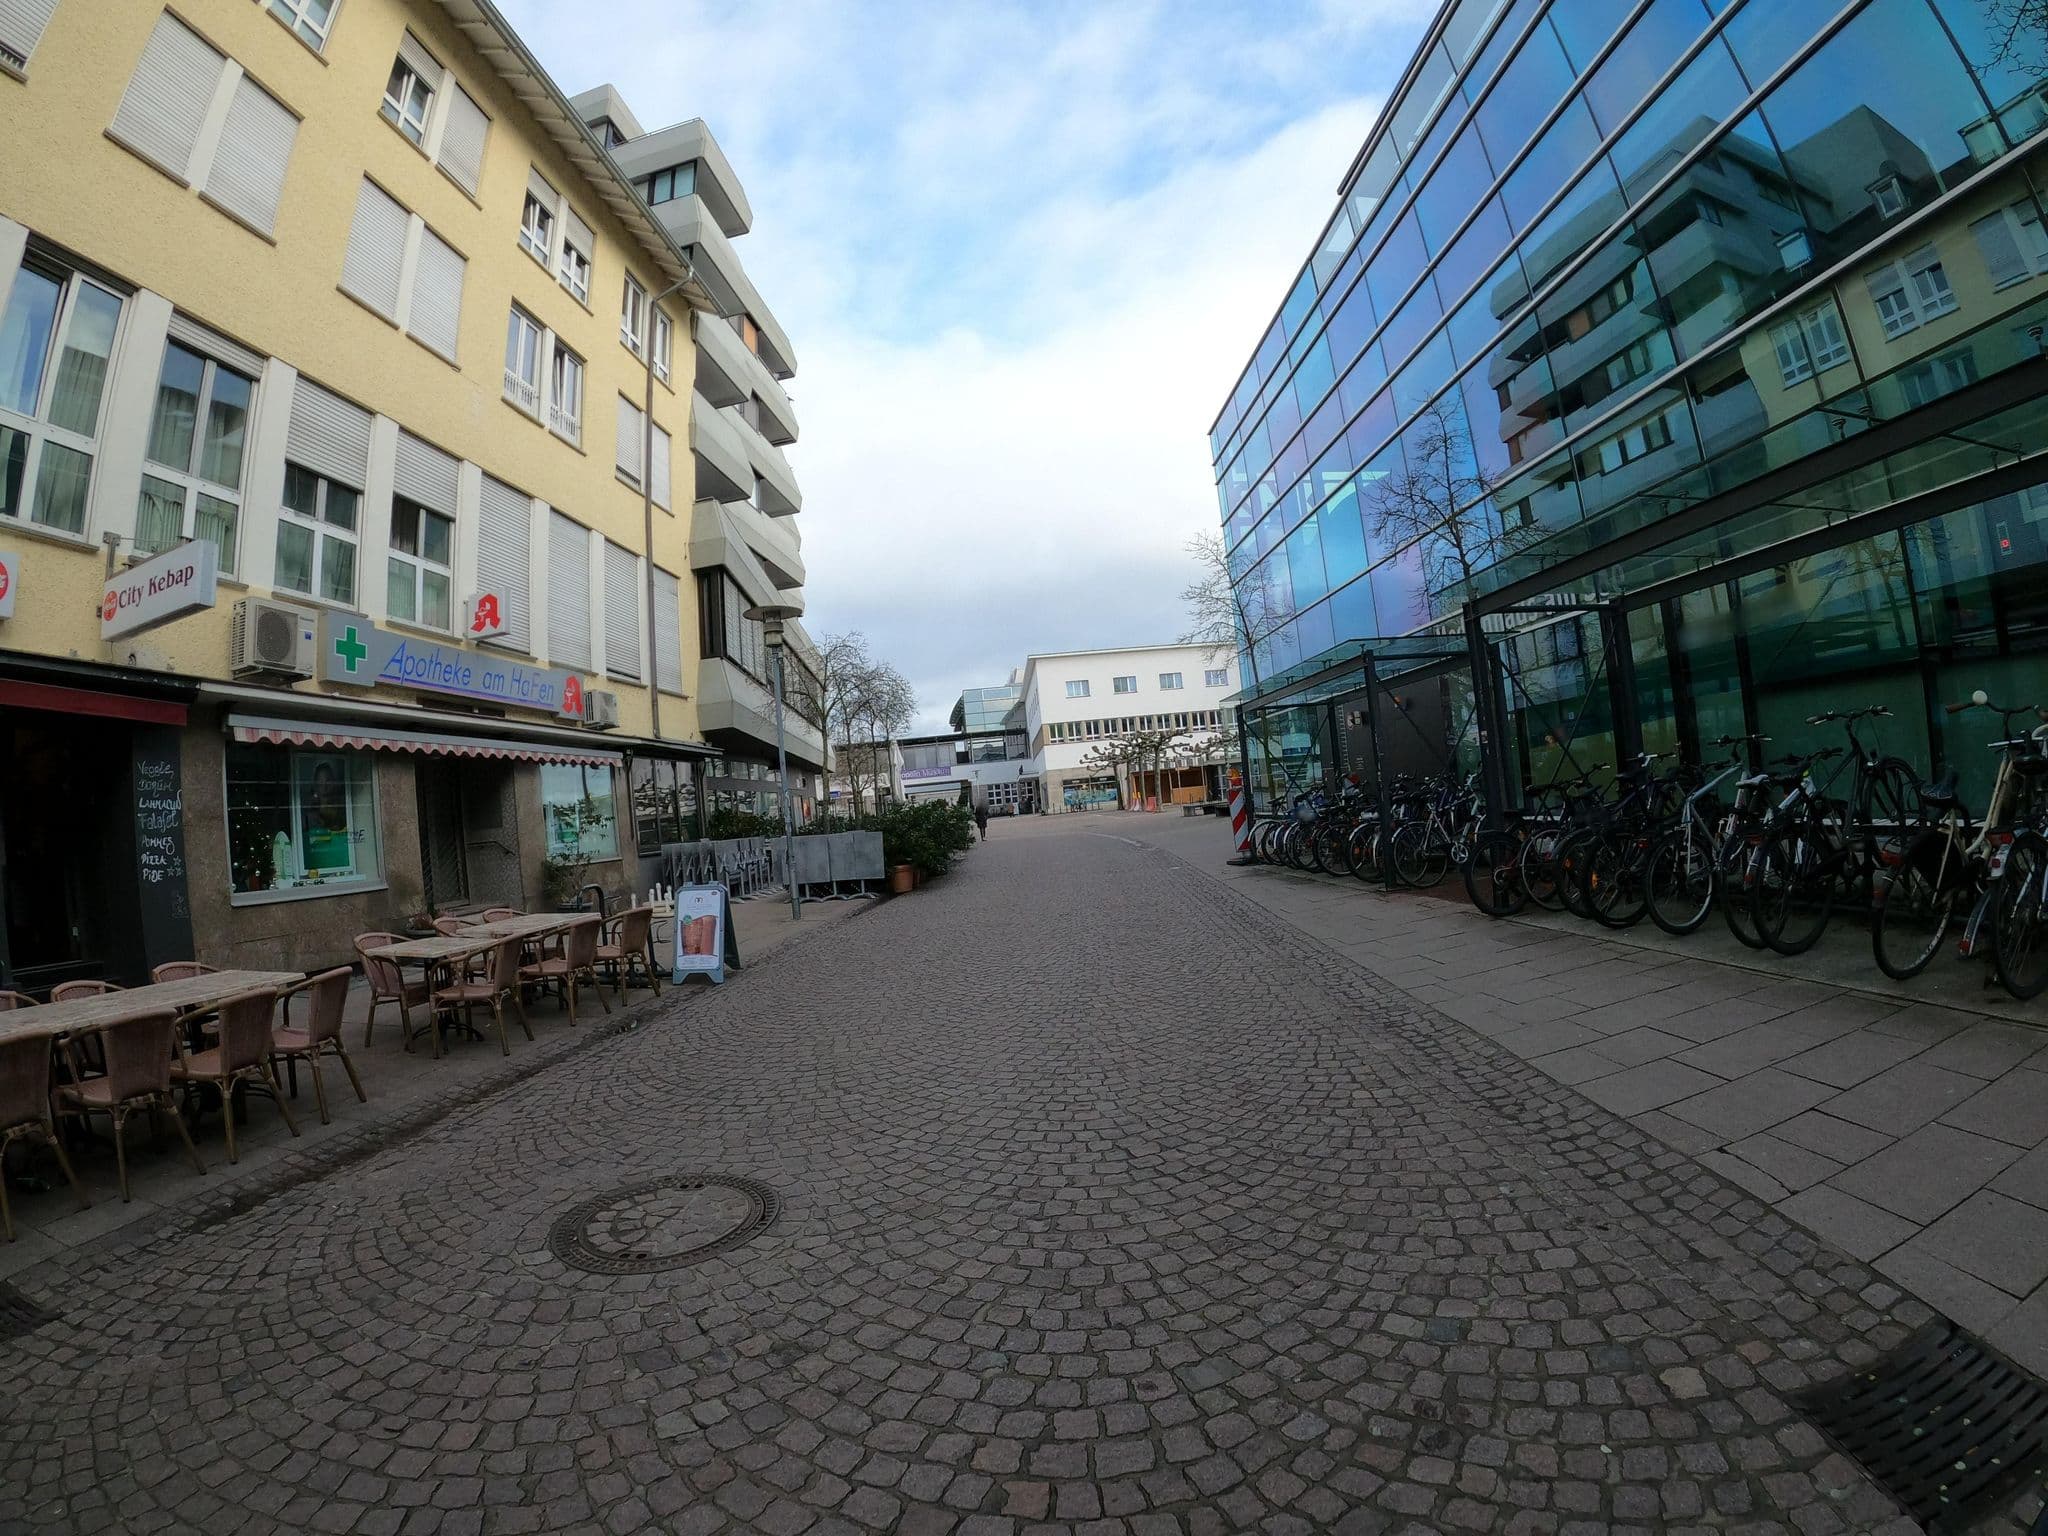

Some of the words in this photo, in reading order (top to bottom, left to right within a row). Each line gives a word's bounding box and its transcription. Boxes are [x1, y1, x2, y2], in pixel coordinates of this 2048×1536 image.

[118, 584, 144, 608] City
[147, 564, 194, 597] Kebap
[383, 639, 472, 685] Apotheke
[482, 671, 505, 692] am
